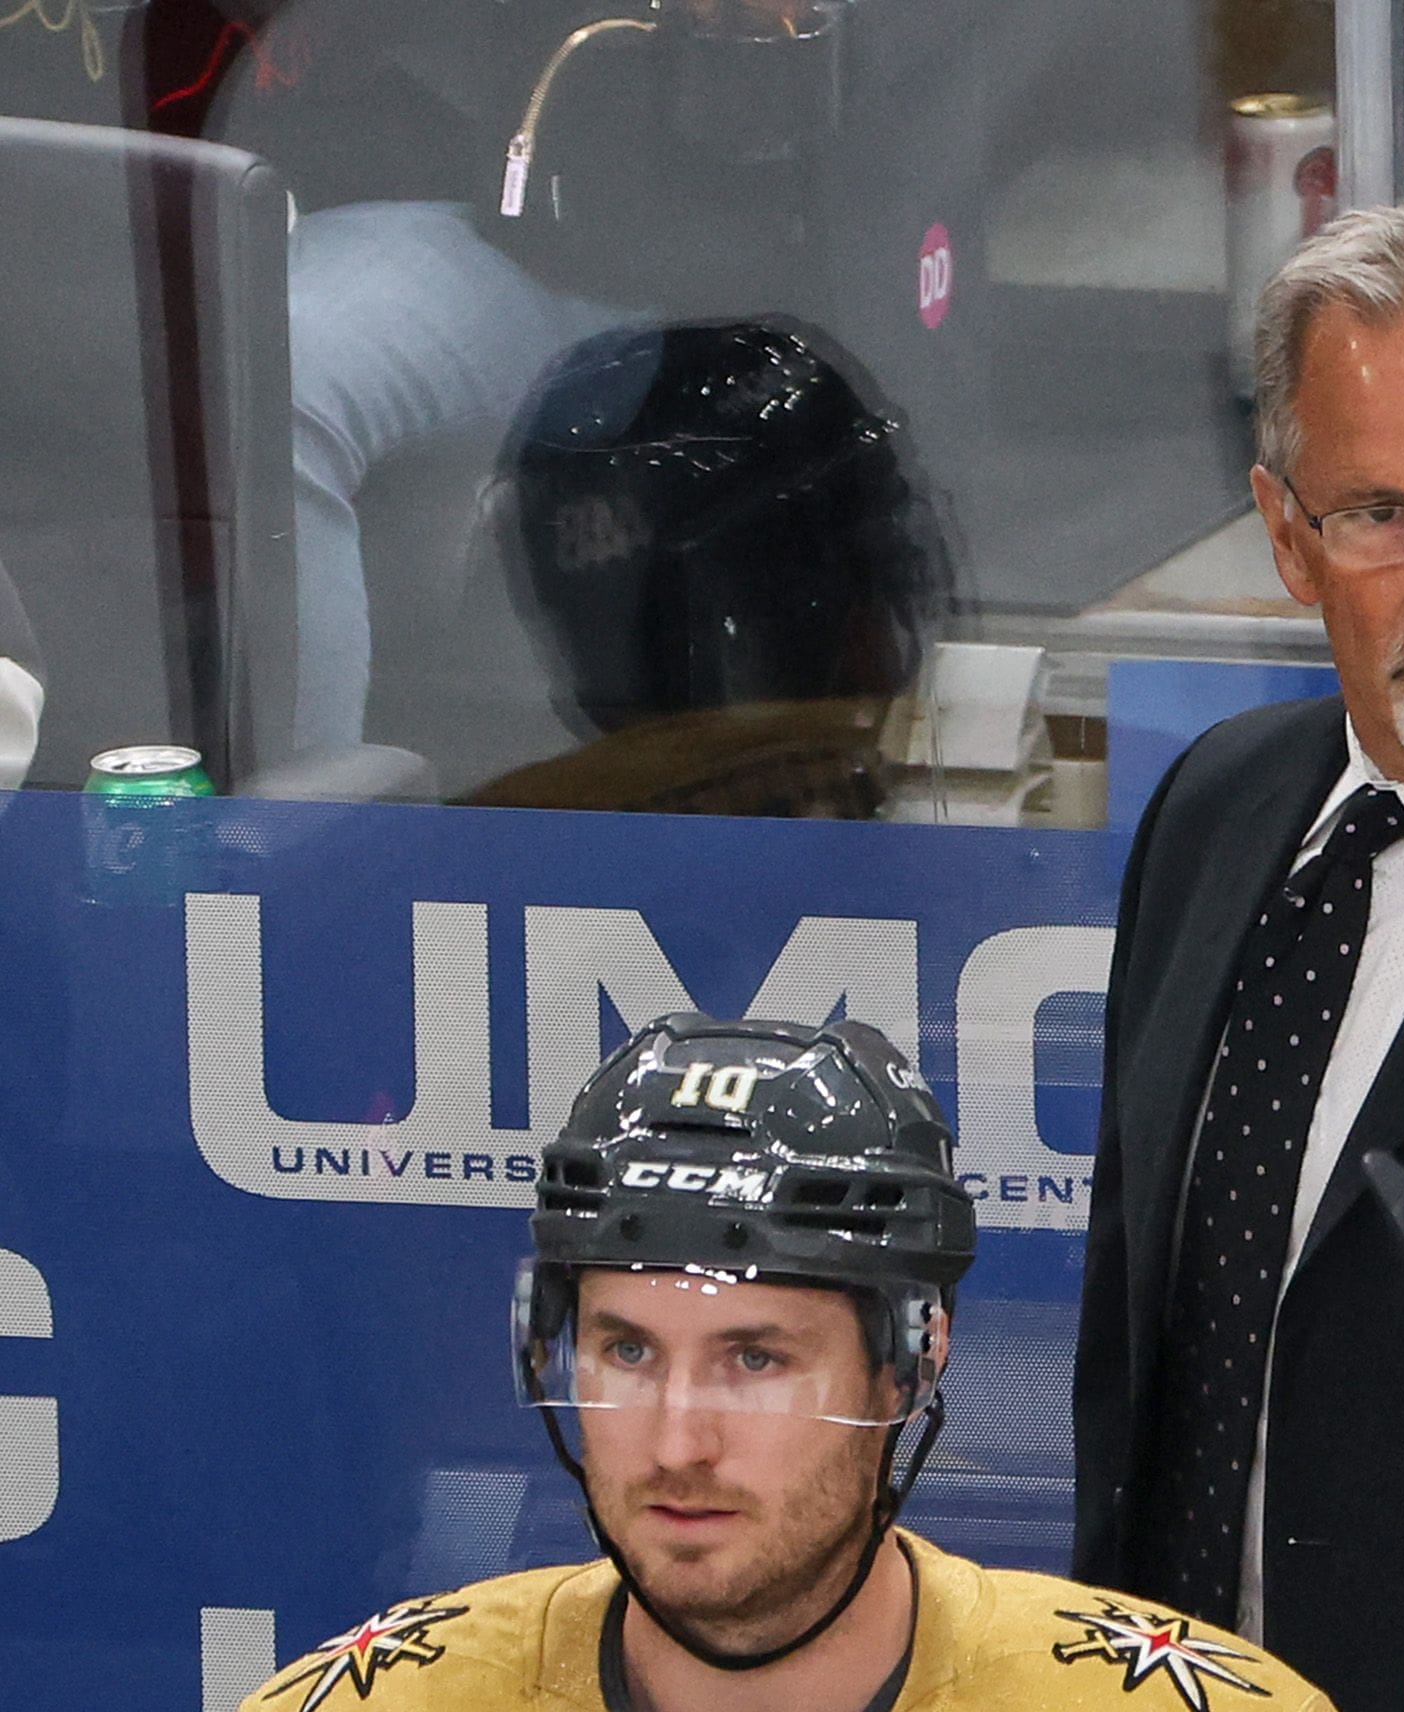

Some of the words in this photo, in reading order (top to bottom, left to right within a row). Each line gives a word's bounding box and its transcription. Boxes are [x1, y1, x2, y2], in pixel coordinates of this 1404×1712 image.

[671, 1062, 758, 1114] 10
[621, 1160, 772, 1202] CCM
[958, 1172, 1094, 1205] CEN
